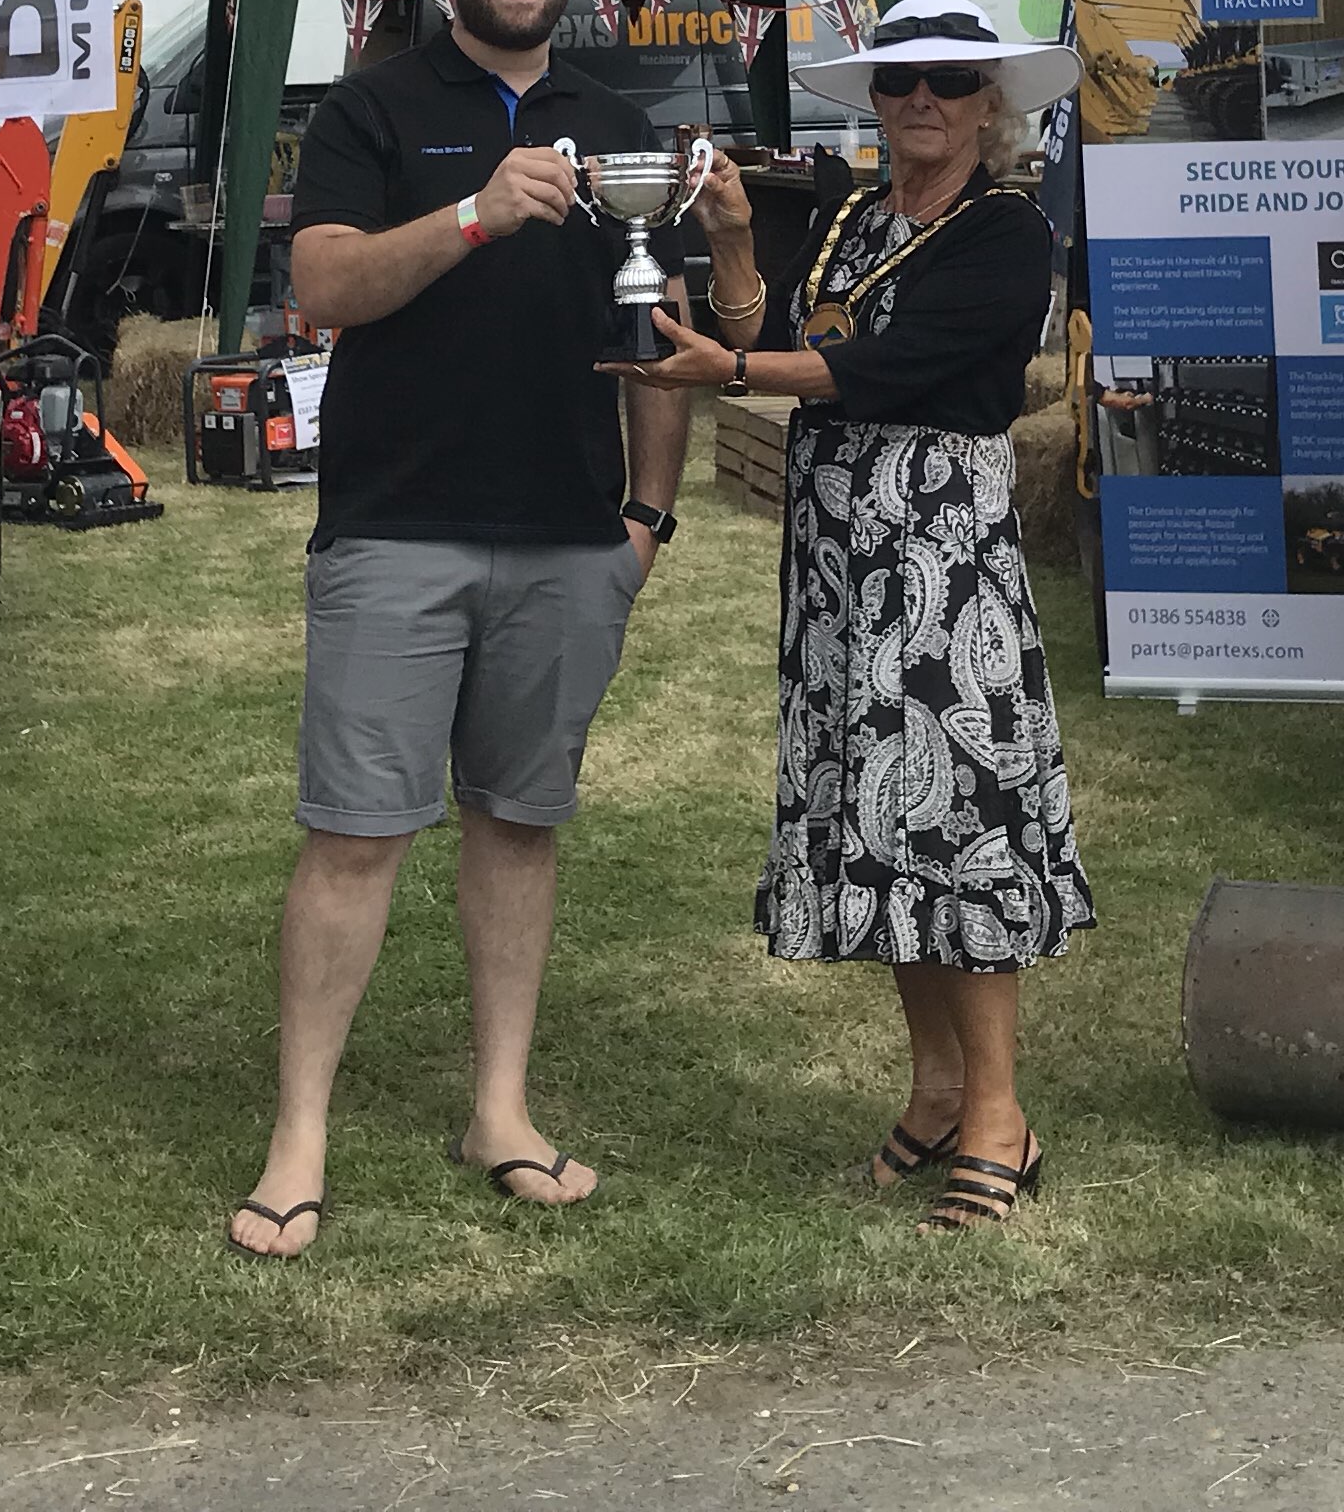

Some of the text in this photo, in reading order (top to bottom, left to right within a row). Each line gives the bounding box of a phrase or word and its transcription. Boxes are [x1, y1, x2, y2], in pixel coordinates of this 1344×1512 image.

[1186, 160, 1277, 182] SECURE
[1180, 192, 1249, 214] PRIDE
[1256, 191, 1308, 212] AND
[1128, 608, 1246, 626] 01386 554838
[1131, 642, 1304, 660] parts@partexs.com
